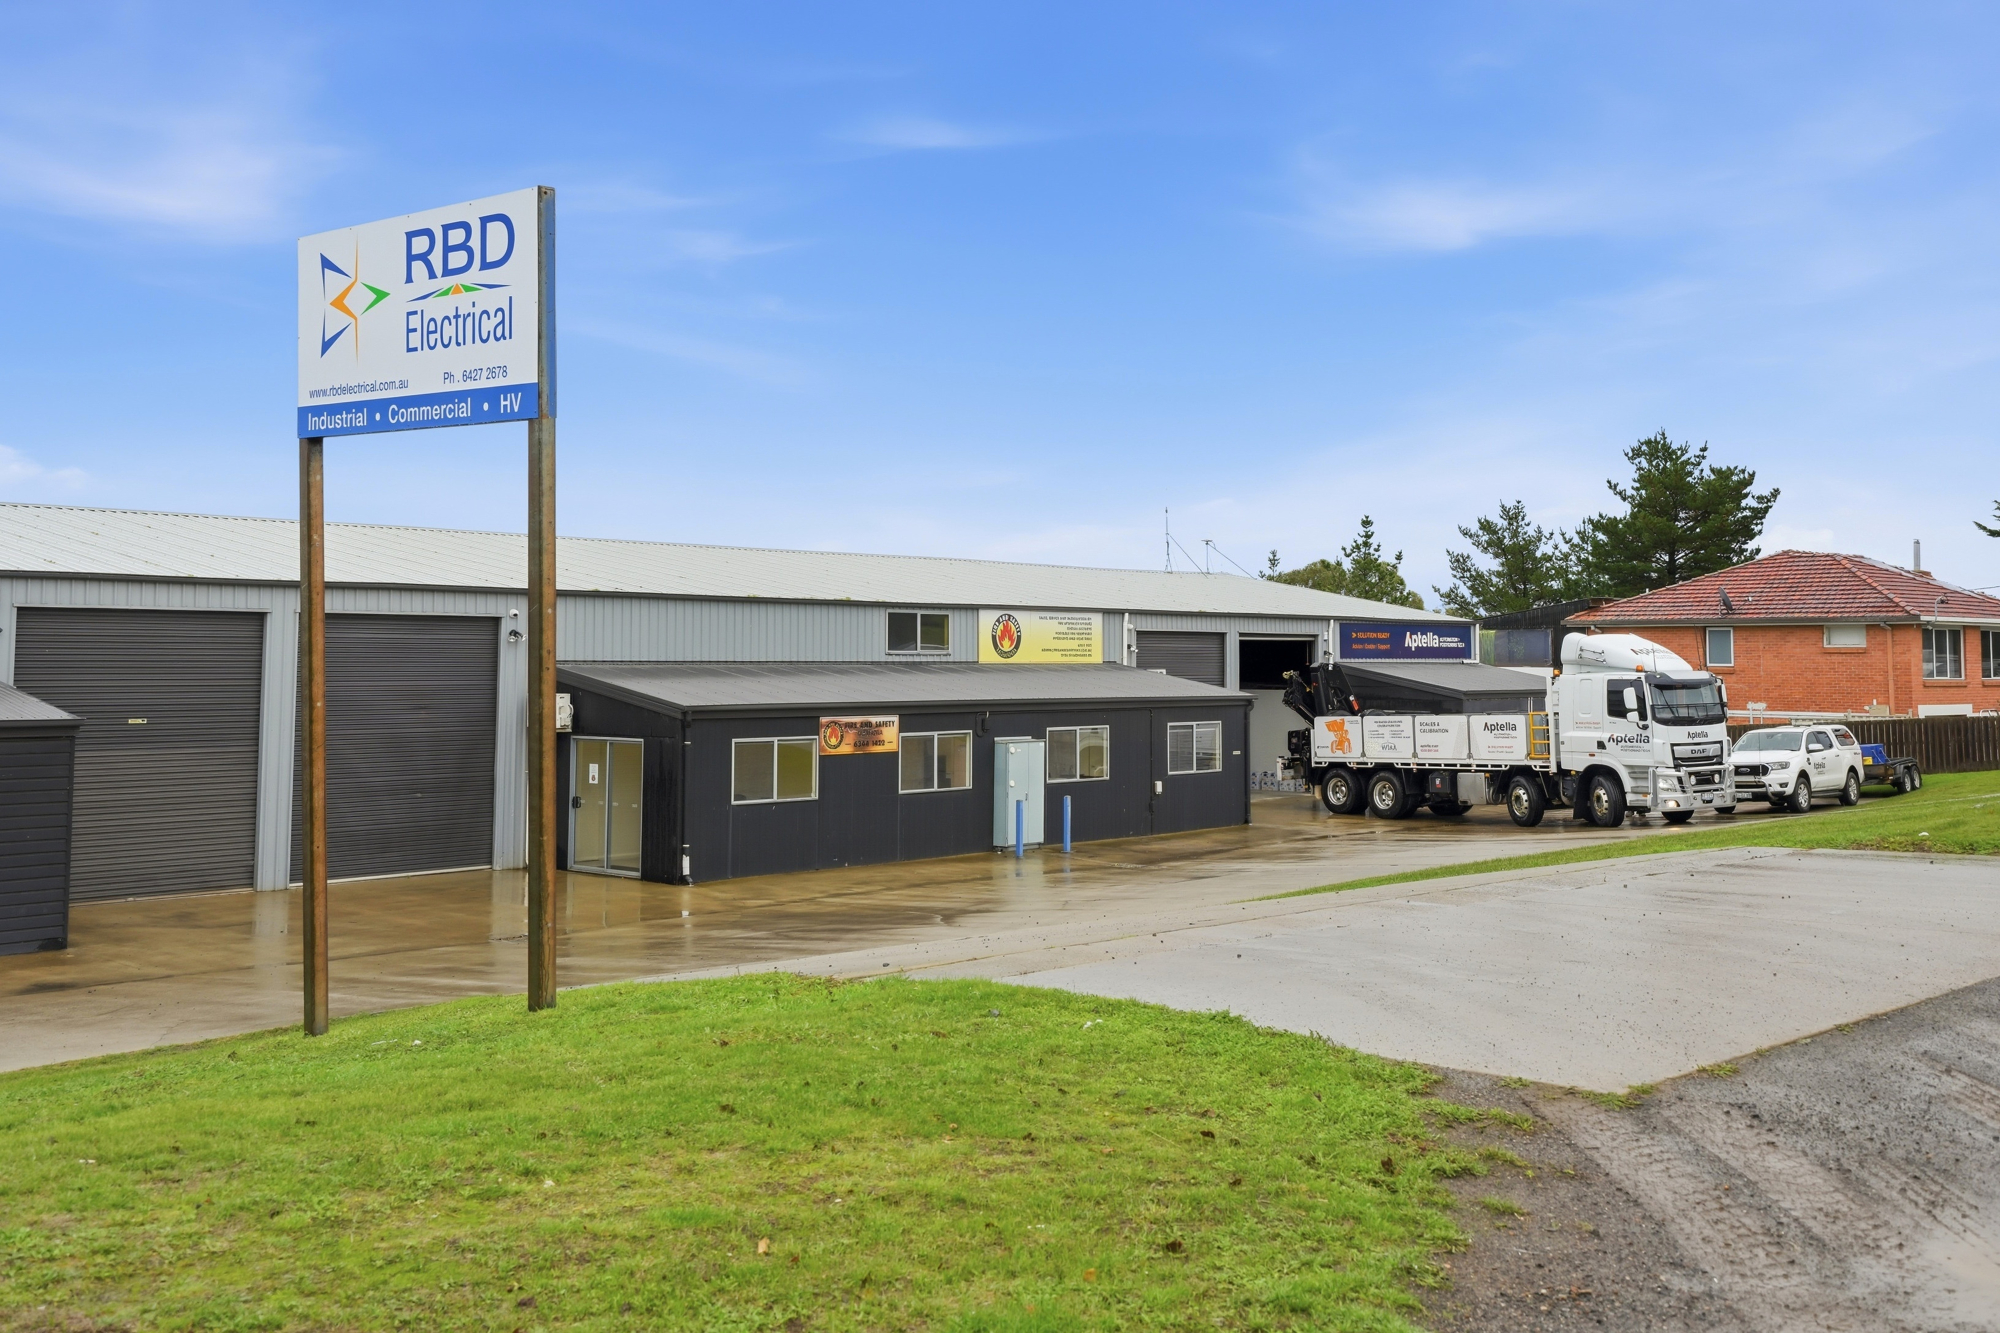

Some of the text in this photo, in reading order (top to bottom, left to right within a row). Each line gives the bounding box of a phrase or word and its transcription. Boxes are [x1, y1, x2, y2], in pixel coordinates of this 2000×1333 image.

[404, 212, 515, 284] RBD
[405, 295, 513, 353] Electrical
[462, 368, 483, 382] 6427
[485, 365, 508, 380] 2678
[308, 379, 409, 398] www.rbdelectrical.com.au
[388, 397, 471, 423] Commercial
[500, 392, 522, 413] HV
[308, 407, 367, 431] Industrial
[1405, 631, 1439, 651] Aptella
[875, 720, 895, 728] SAFETY
[1483, 721, 1517, 734] Aptella
[1607, 733, 1650, 746] Aptella
[1685, 730, 1709, 740] Aptella
